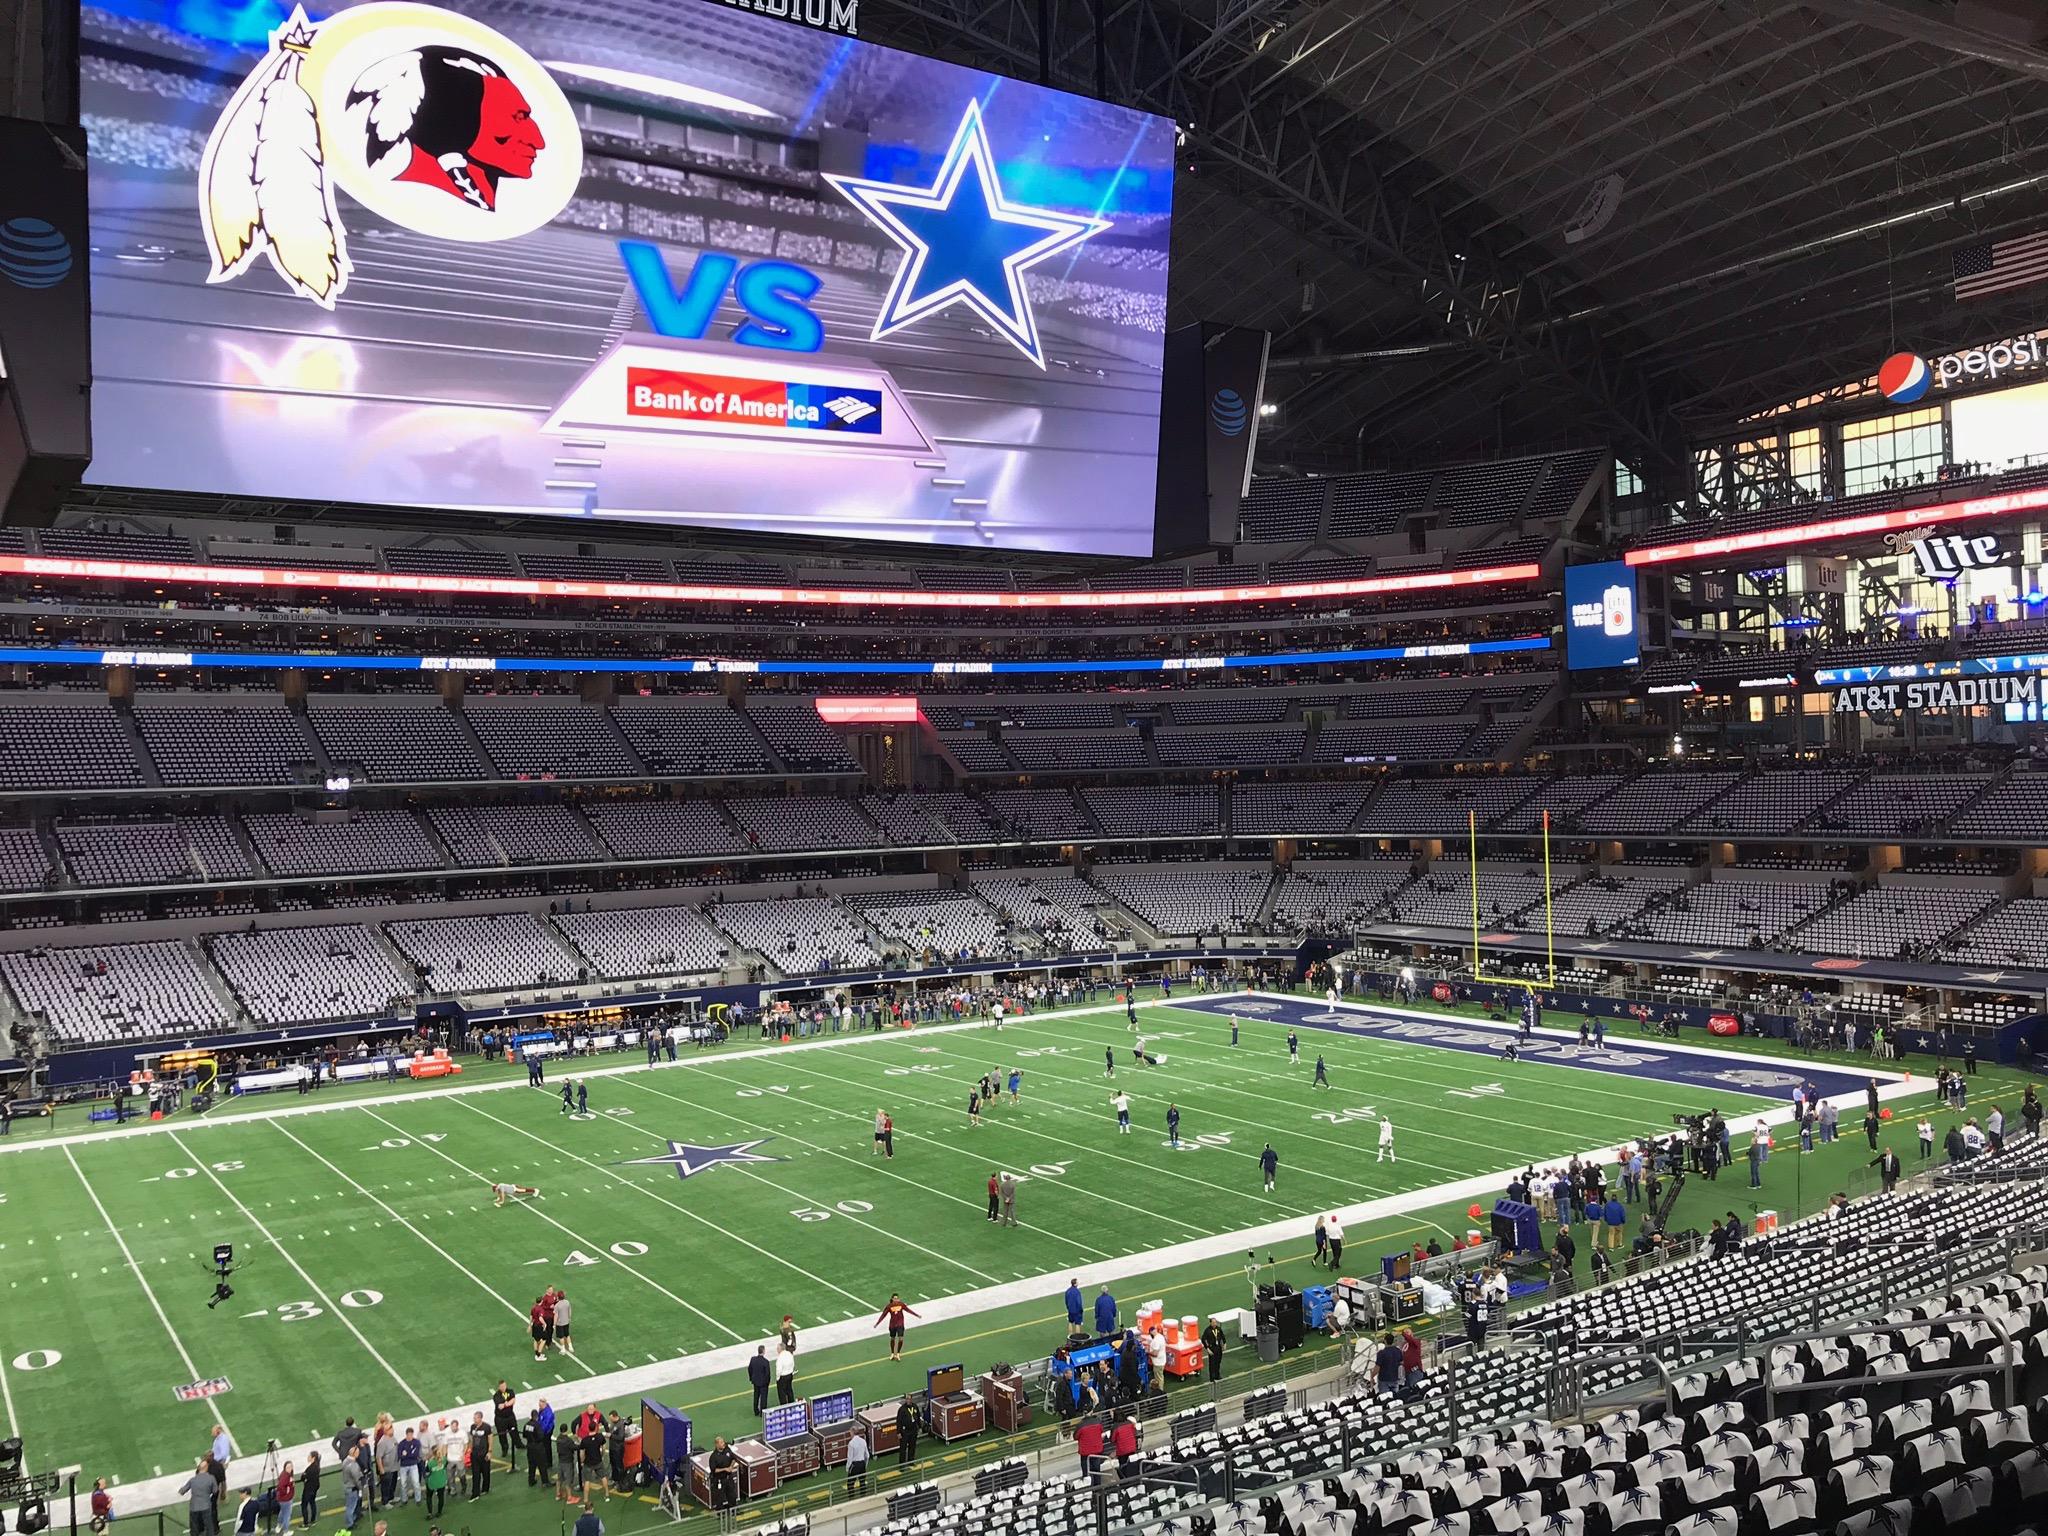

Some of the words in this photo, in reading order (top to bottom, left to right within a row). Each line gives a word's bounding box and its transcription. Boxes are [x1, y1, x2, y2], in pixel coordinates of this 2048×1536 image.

[617, 240, 825, 353] VS
[1939, 333, 2039, 388] pepsi
[634, 385, 697, 412] Bank
[699, 392, 724, 413] of
[726, 394, 819, 423] America
[1884, 525, 1936, 555] Miller
[1913, 535, 2000, 578] Lite
[1818, 565, 1838, 587] Lite
[1704, 583, 1724, 602] Lite
[96, 607, 139, 616] MEREDITH
[101, 652, 134, 664] AT&T
[136, 652, 192, 665] STADIUM
[421, 657, 447, 669] AT&T
[448, 658, 496, 669] STADIUM
[1836, 685, 1899, 712] AT&T
[1907, 676, 2037, 708] STADIUM
[1967, 1135, 1978, 1144] 88
[1534, 1184, 1541, 1192] 12
[789, 1200, 874, 1222] 50
[563, 1241, 649, 1266] 40
[277, 1289, 384, 1321] 30
[1189, 1354, 1197, 1366] G
